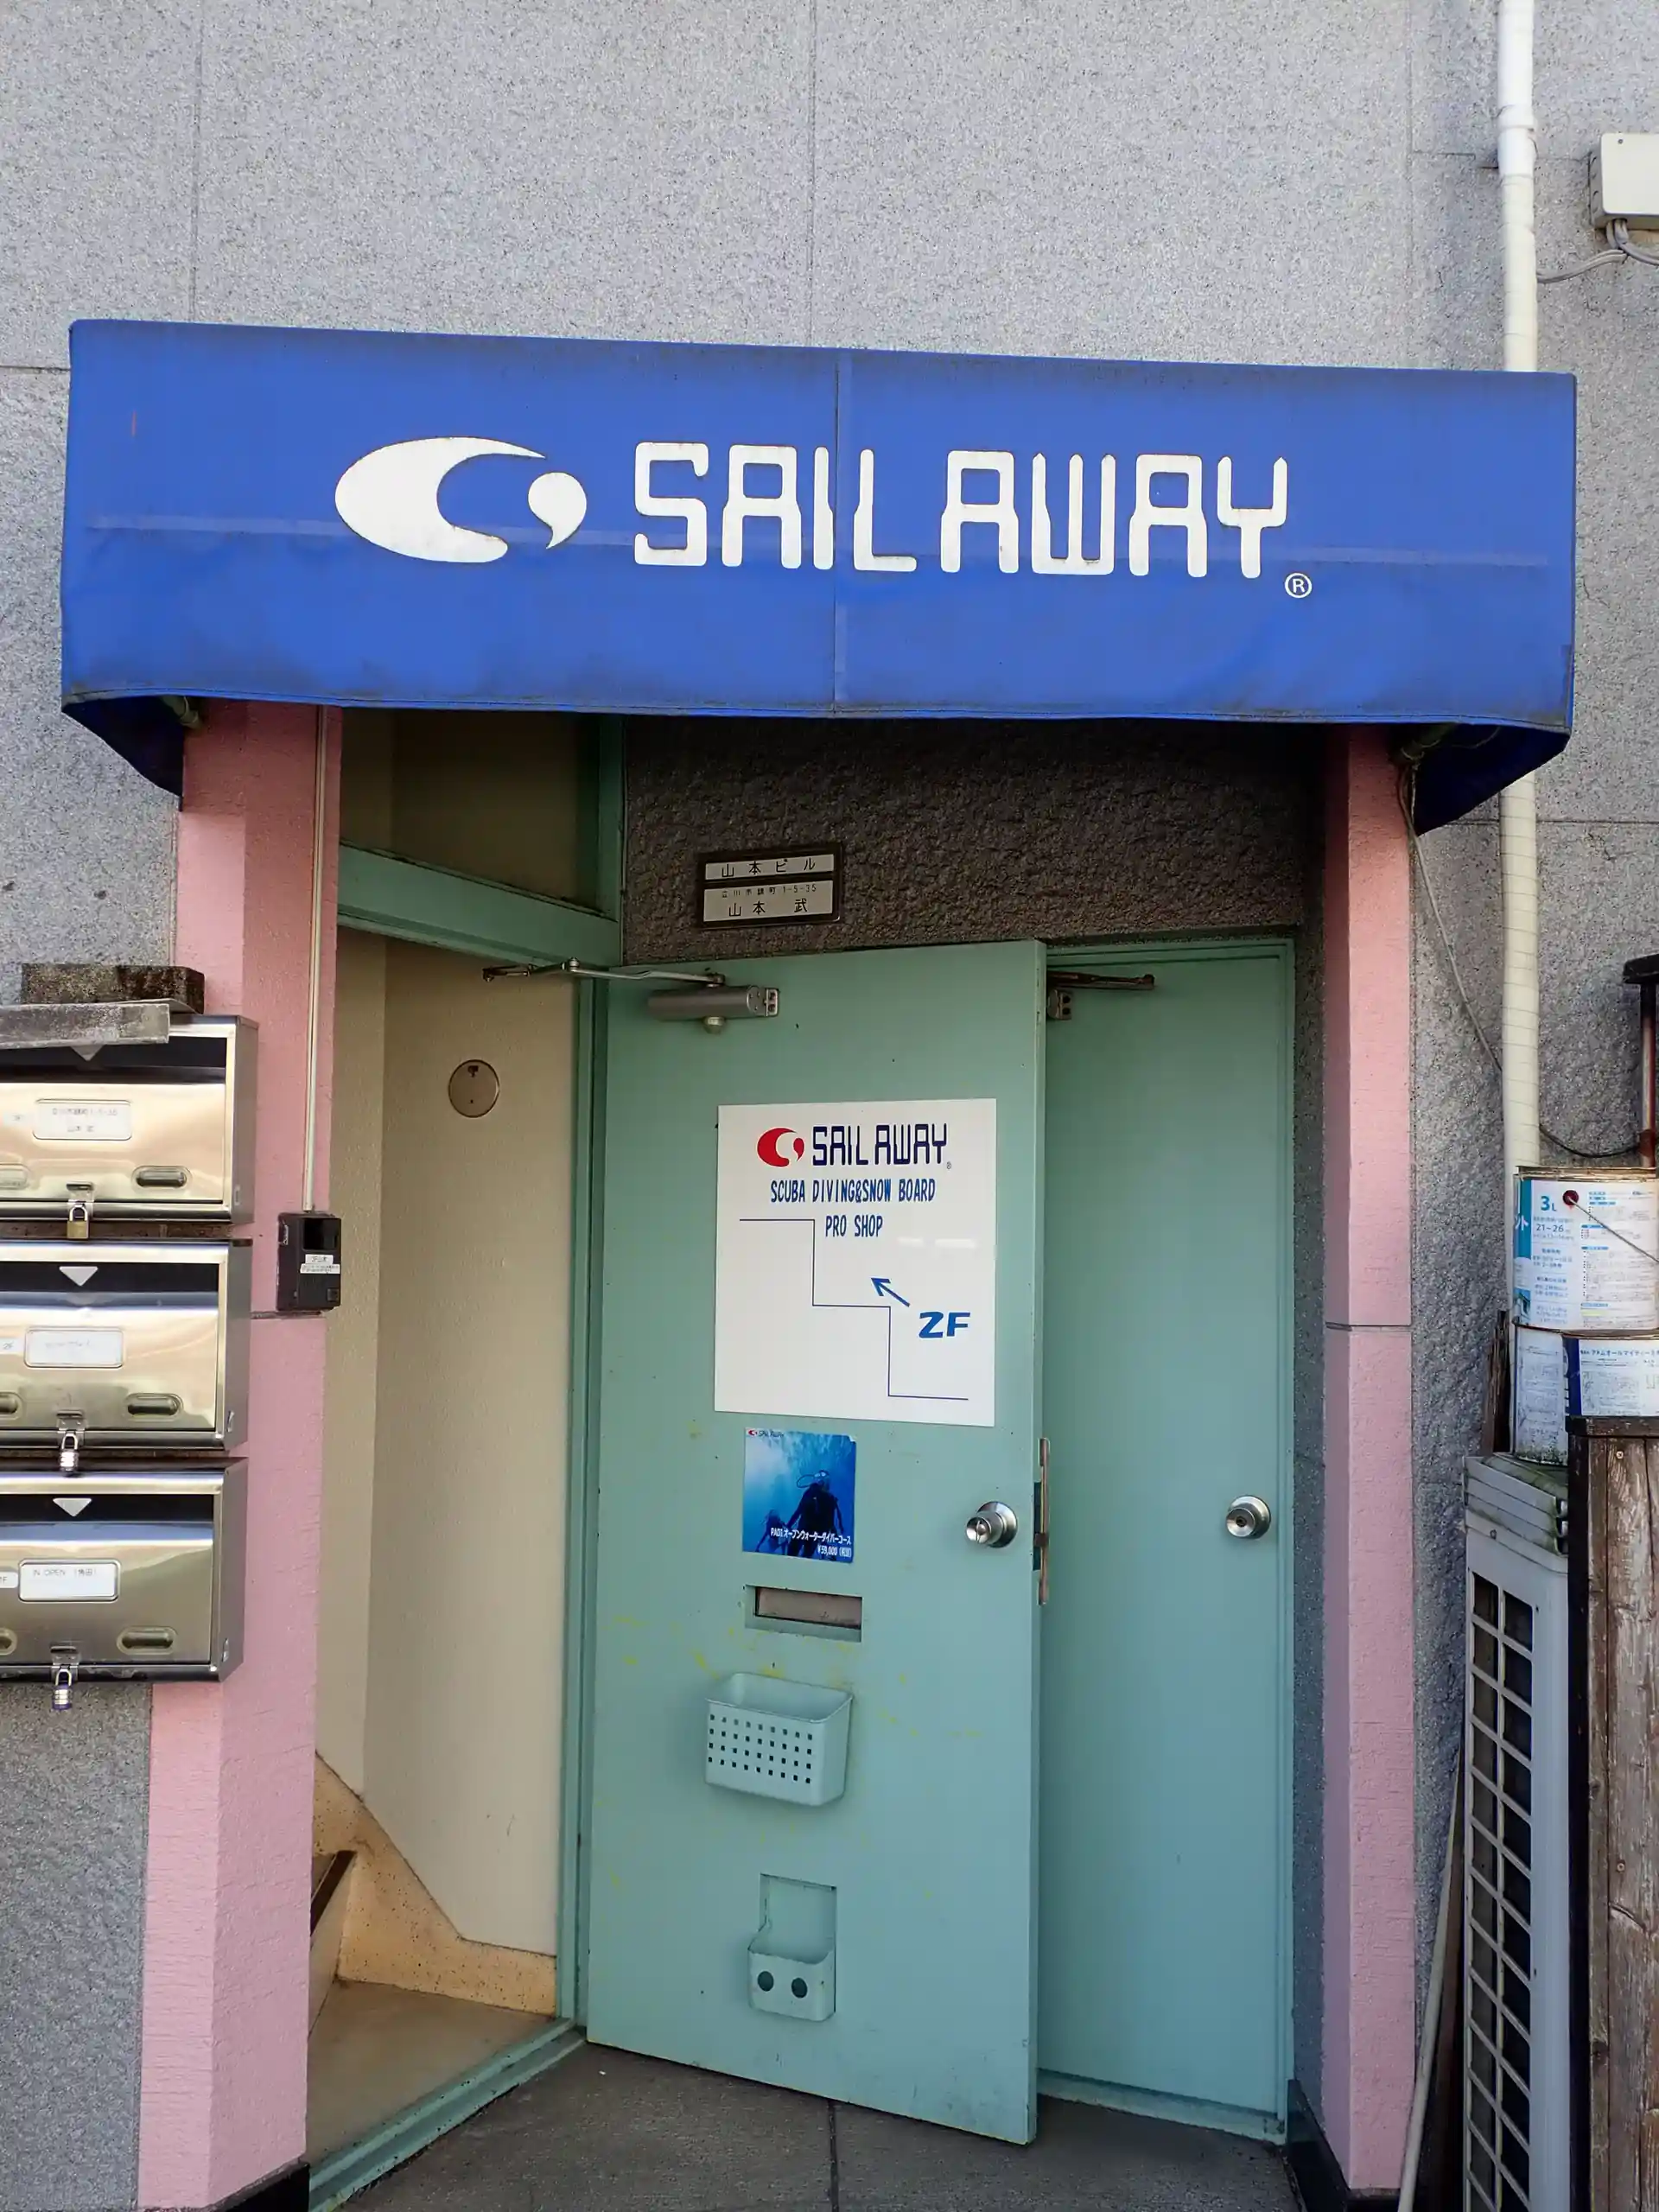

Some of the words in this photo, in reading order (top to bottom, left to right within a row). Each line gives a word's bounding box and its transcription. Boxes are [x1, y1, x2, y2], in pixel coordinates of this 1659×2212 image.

[721, 857, 816, 878] 山本ビル
[771, 1179, 805, 1203] SCUBA
[899, 1179, 936, 1202] BOARD
[825, 1216, 847, 1237] PRO
[855, 1215, 883, 1237] SHOP
